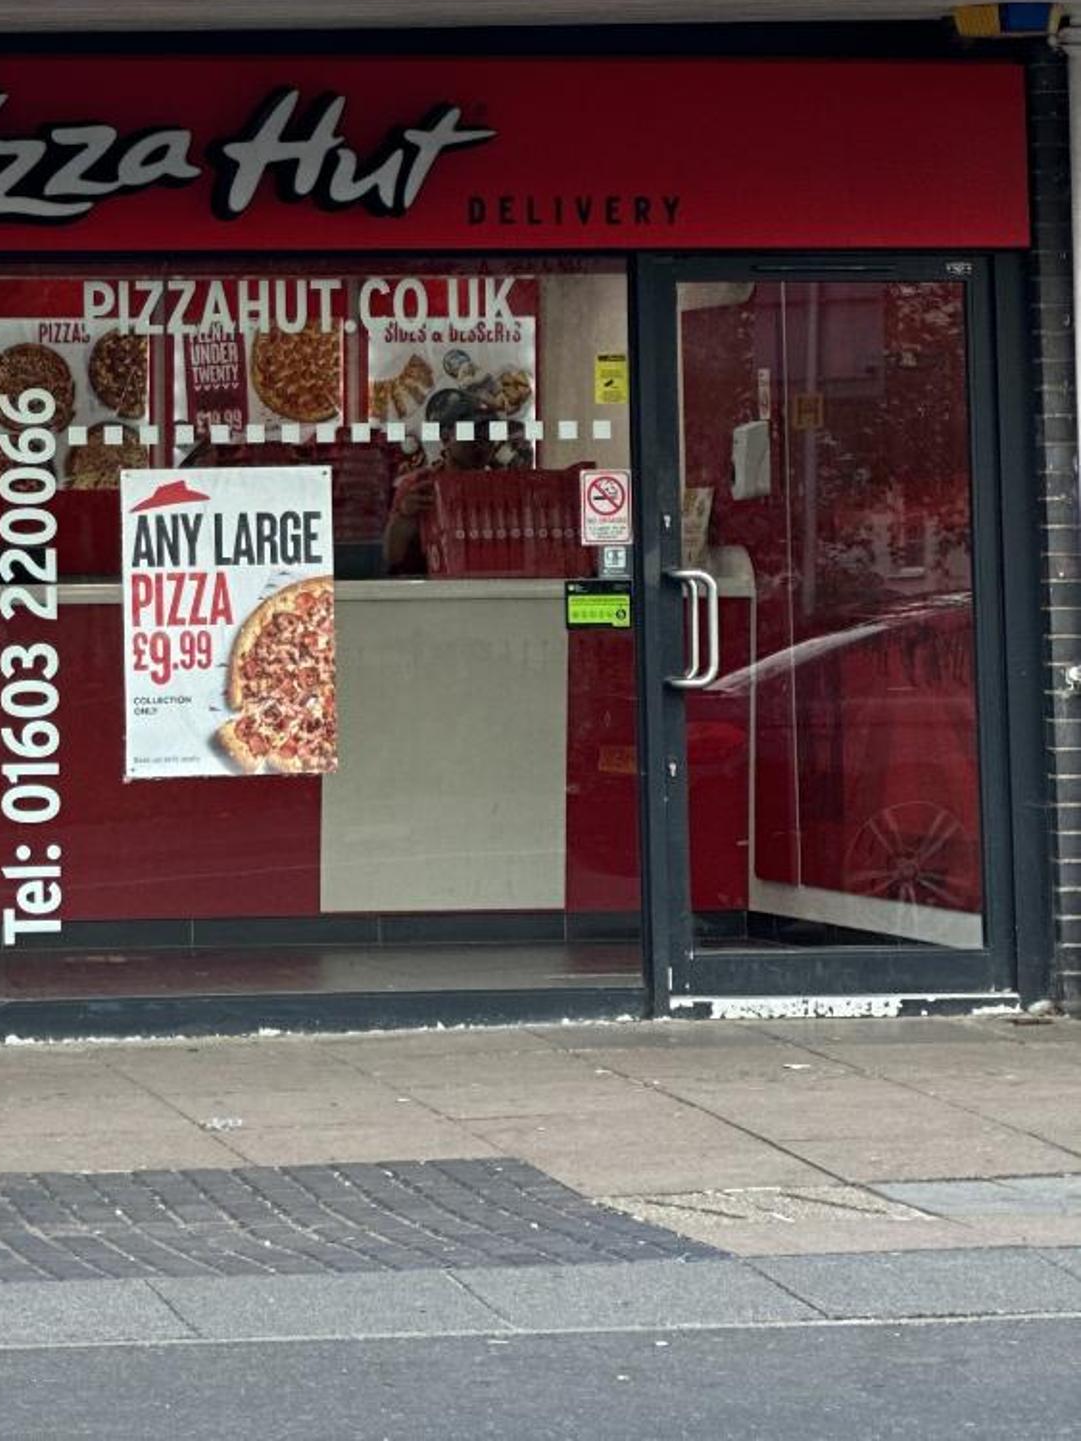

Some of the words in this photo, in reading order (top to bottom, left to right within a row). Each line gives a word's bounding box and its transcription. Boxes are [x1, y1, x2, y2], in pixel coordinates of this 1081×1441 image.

[222, 89, 498, 213] Hut
[467, 196, 683, 226] DELIVERY
[191, 342, 238, 366] UNDER
[192, 364, 238, 384] TWENTY
[195, 408, 242, 433] £1999
[131, 512, 203, 568] ANY
[213, 511, 322, 566] LARGE
[131, 570, 235, 628] PIZZA
[133, 631, 213, 686] £9.99
[133, 696, 192, 706] COLLECTION
[0, 642, 61, 825] 01603
[1, 843, 63, 946] Tel:
